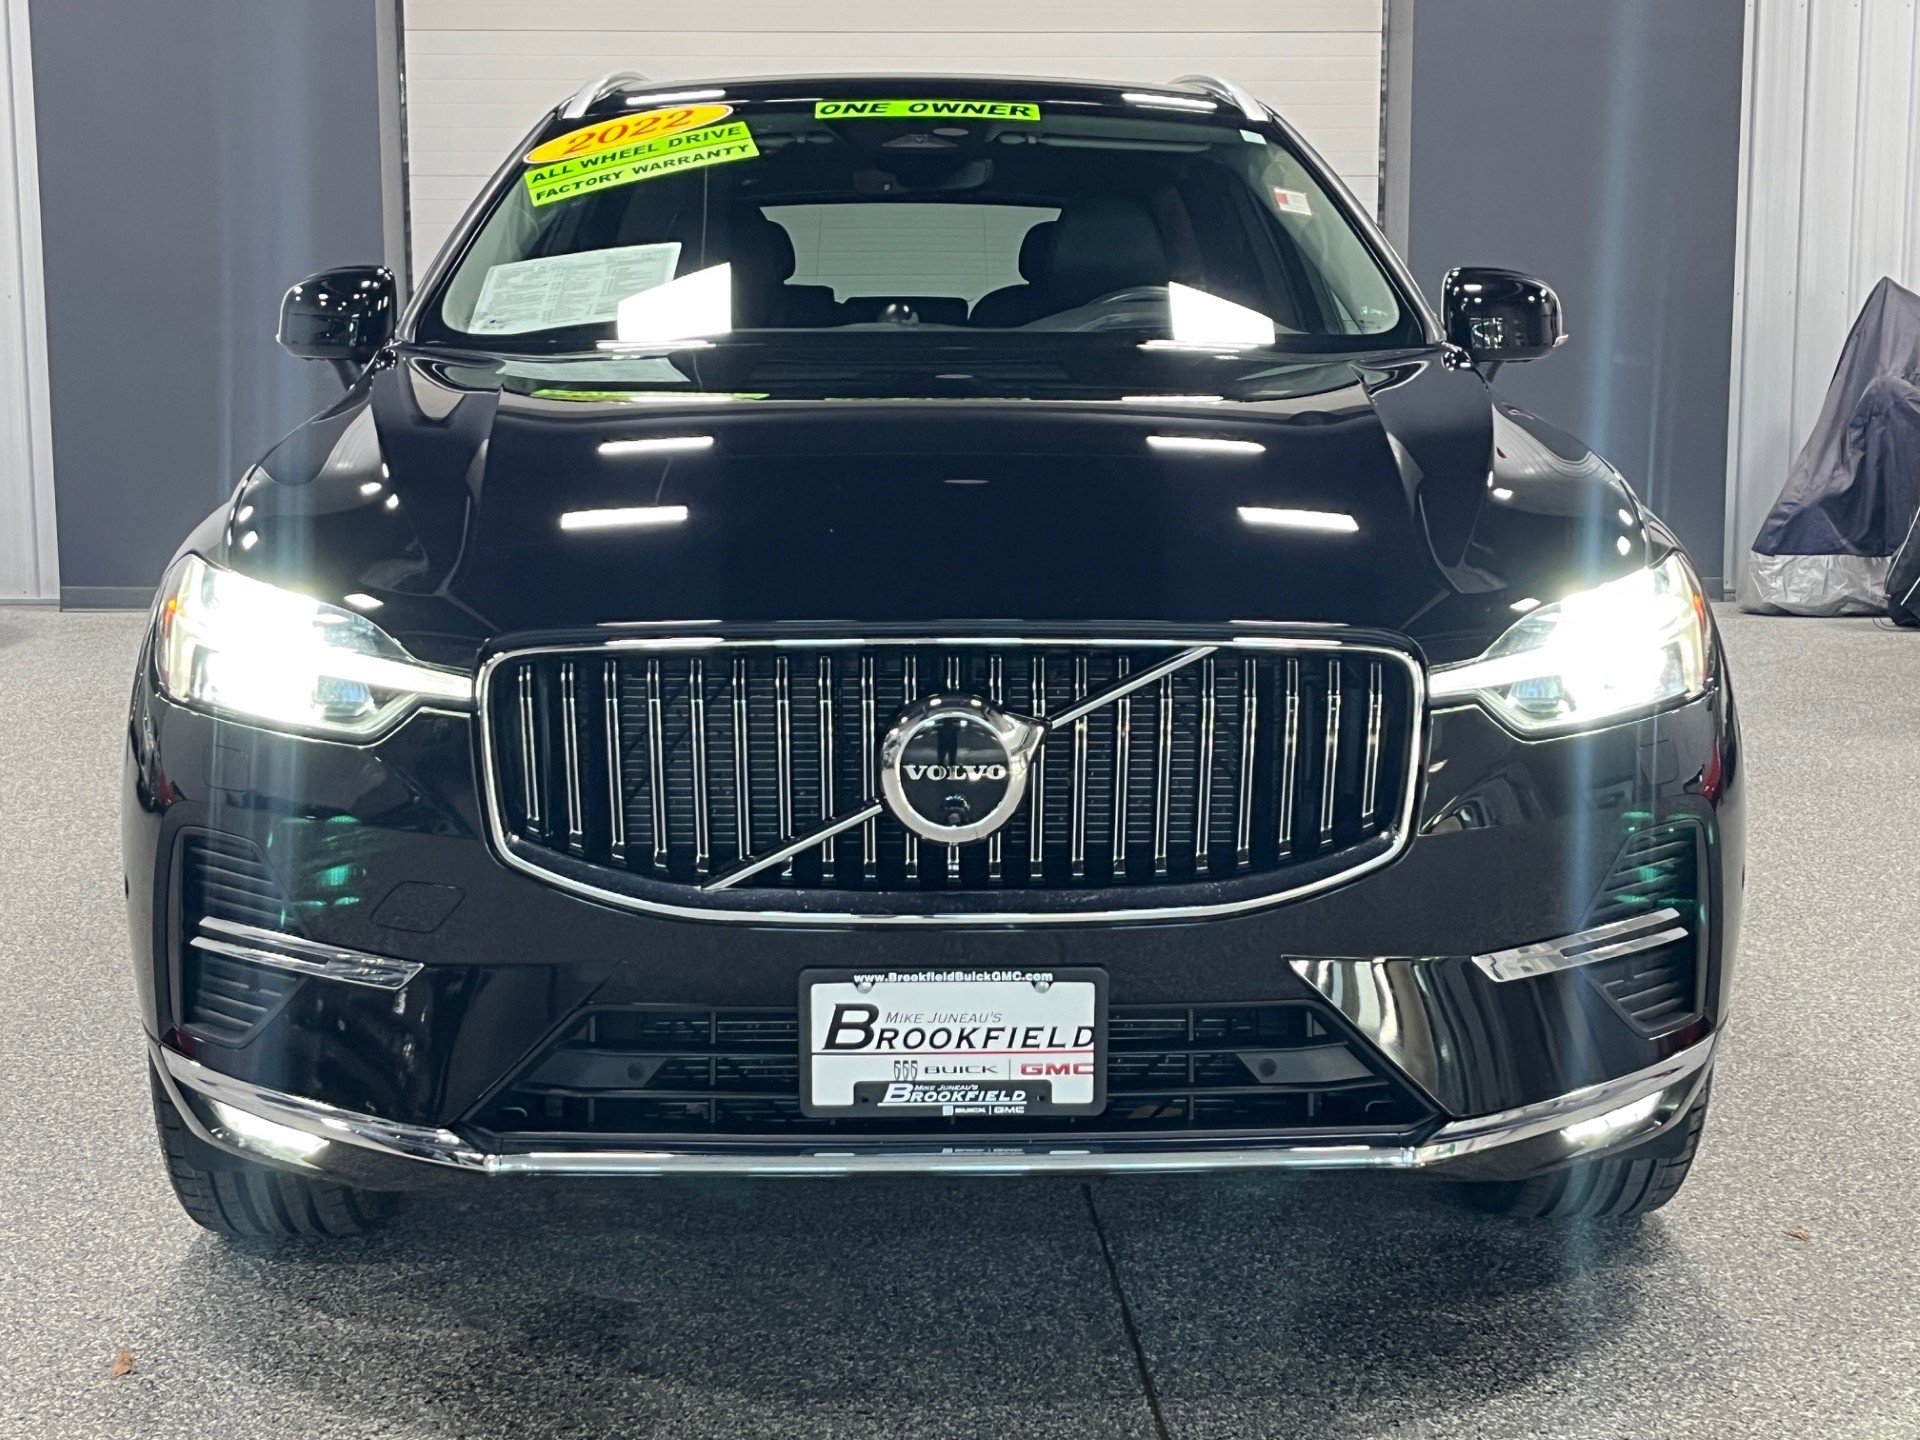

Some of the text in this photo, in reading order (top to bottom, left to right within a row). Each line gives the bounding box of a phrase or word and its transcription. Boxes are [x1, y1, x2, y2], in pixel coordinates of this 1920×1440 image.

[819, 103, 1031, 117] ONE OWNER
[562, 109, 695, 155] 2022
[532, 126, 742, 184] ALL WHEEL DRIVE
[536, 144, 750, 202] FACTORY WARRANTY
[902, 764, 1008, 780] VOLVO
[854, 971, 1054, 983] www.BrookfieldBuickGMC.com
[885, 1011, 1003, 1024] MIKE JUNEAU'S
[823, 1003, 1094, 1050] BROOKFIELD
[924, 1063, 1094, 1076] BUICK GMC
[882, 1083, 1027, 1103] BROOKFIELD
[994, 1106, 1025, 1114] GMC
